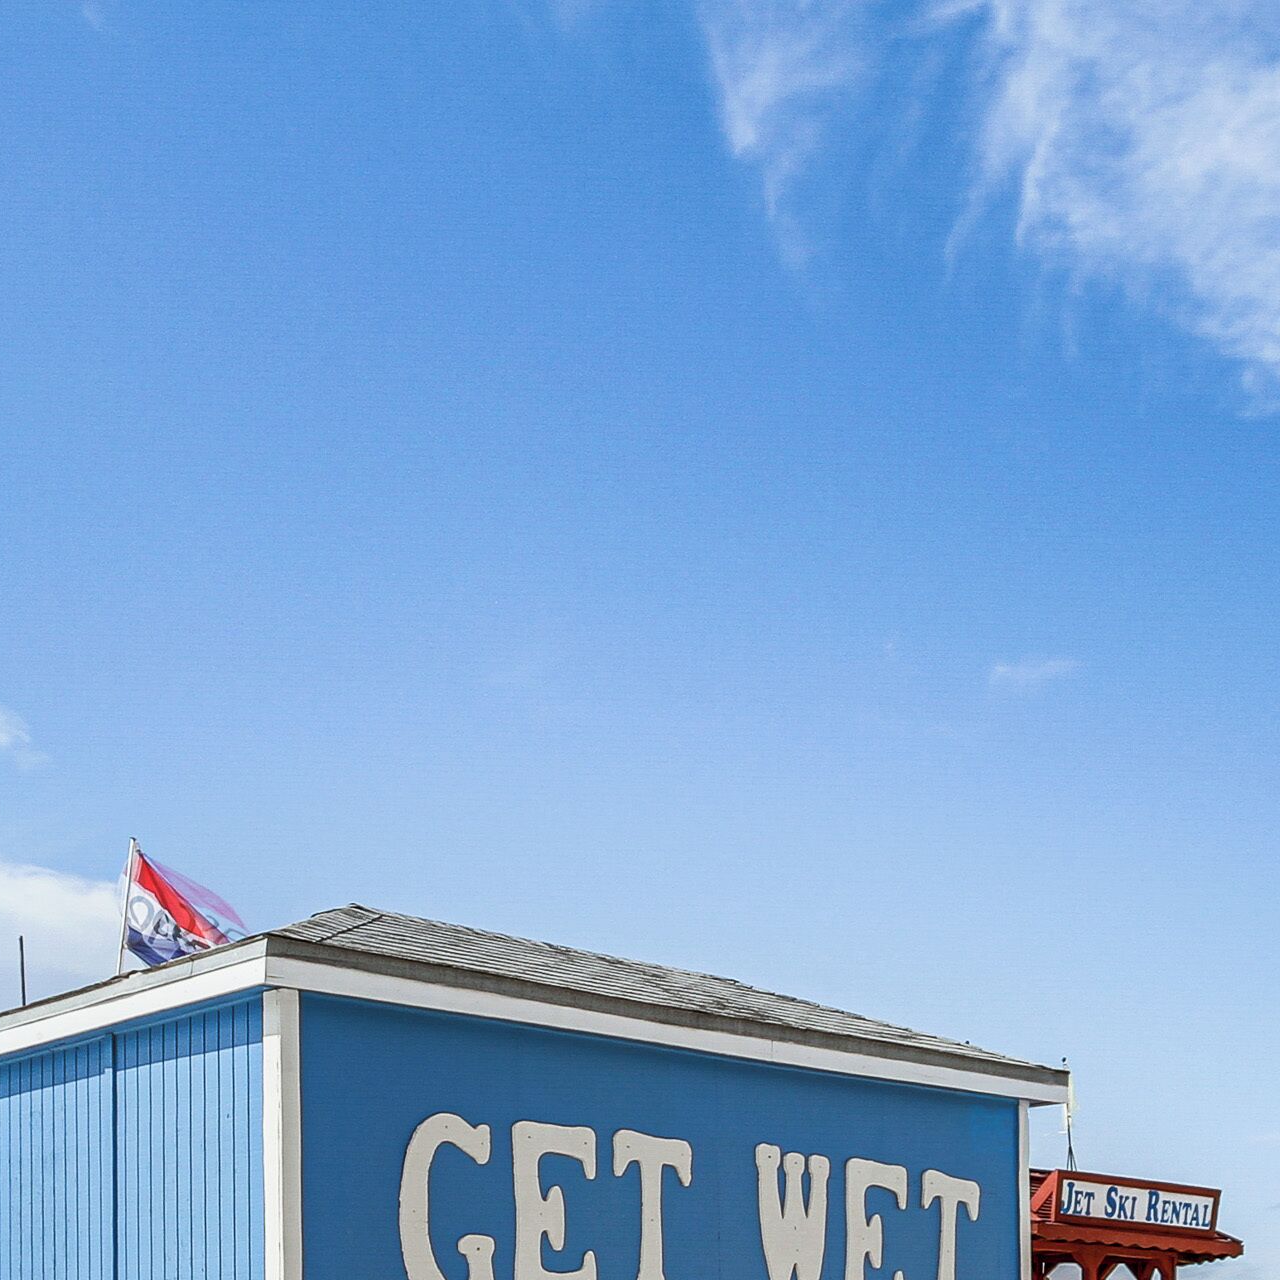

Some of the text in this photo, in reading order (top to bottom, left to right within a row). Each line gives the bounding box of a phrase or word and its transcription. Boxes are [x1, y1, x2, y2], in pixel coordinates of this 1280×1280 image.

[1061, 1182, 1211, 1228] JET SKI RENTAL
